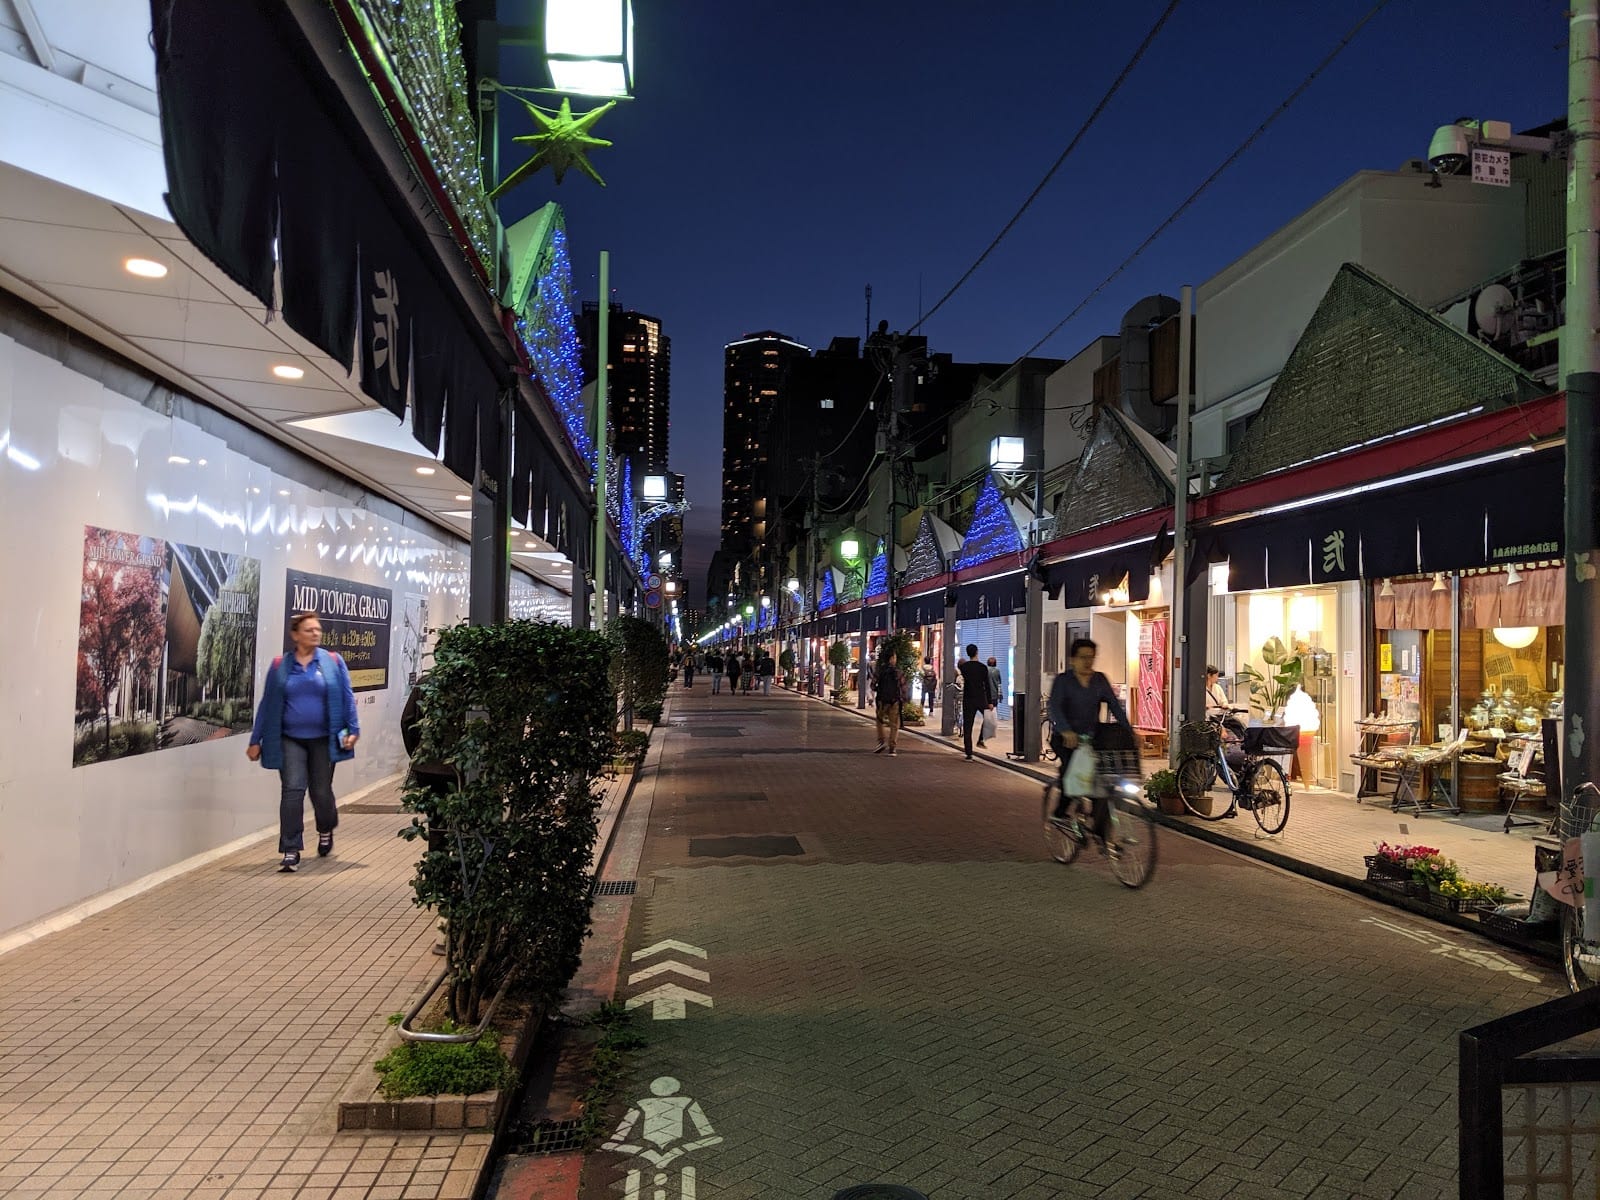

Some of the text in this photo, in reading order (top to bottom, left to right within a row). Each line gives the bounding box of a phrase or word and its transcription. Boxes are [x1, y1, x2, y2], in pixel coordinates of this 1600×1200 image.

[1474, 153, 1509, 165] 防犯カメラ
[106, 547, 134, 564] TOWER
[136, 551, 162, 567] GRAND
[292, 584, 318, 612] MID
[321, 588, 357, 617] TOWER
[358, 595, 389, 620] GRAND
